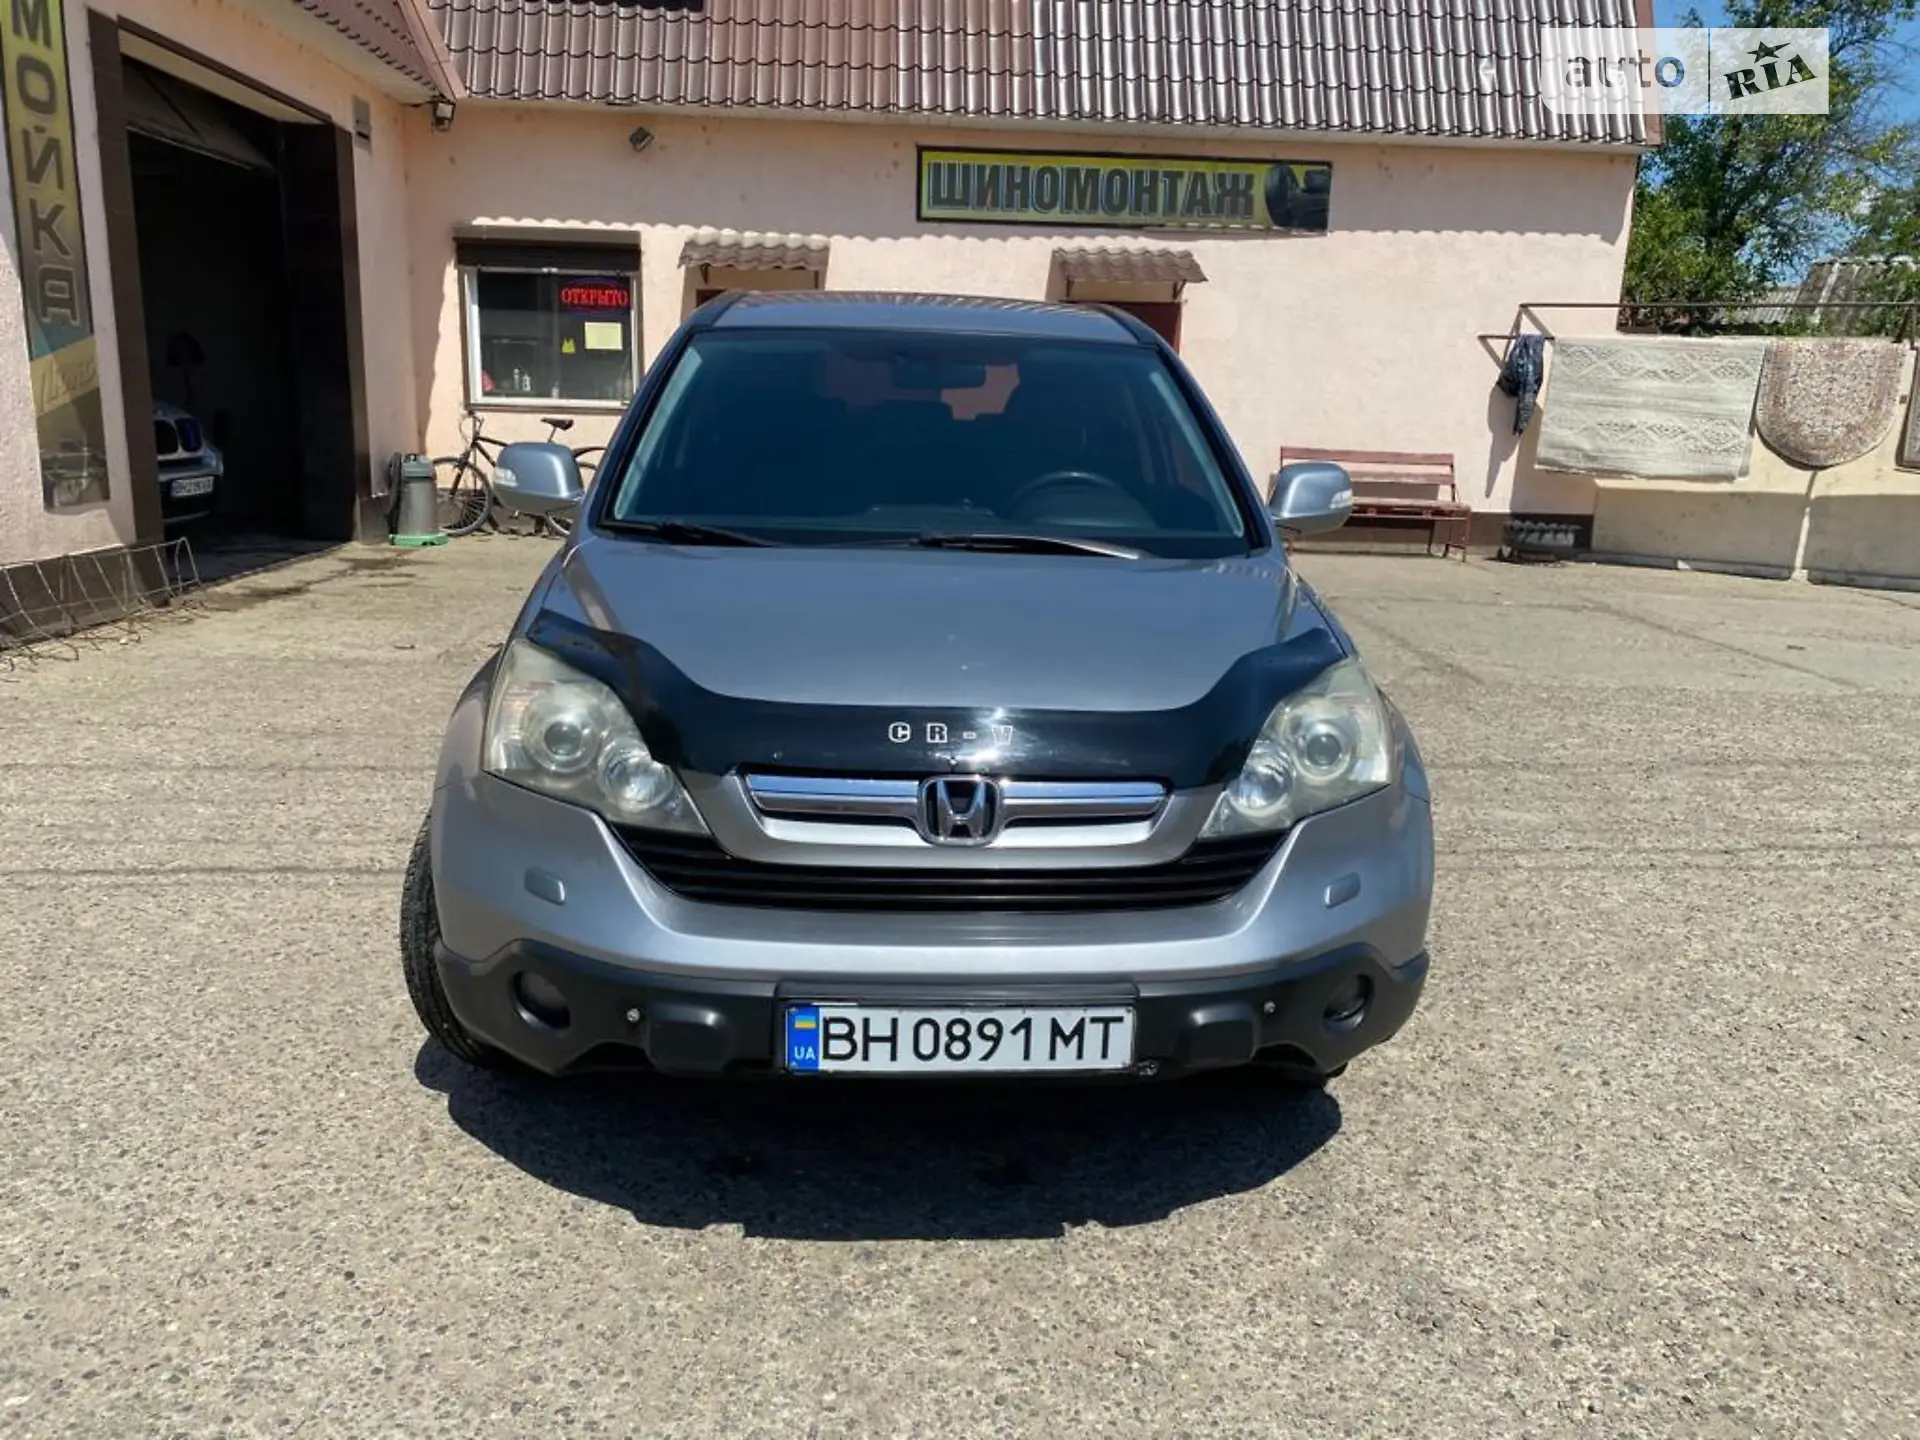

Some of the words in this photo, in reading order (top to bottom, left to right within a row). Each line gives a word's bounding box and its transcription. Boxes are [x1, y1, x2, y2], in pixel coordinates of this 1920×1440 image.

[10, 0, 82, 327] МОЙКА
[926, 160, 1255, 219] ШИНОМОНТАЖ
[561, 288, 628, 306] ОТКРЫТО
[794, 1046, 816, 1061] UA
